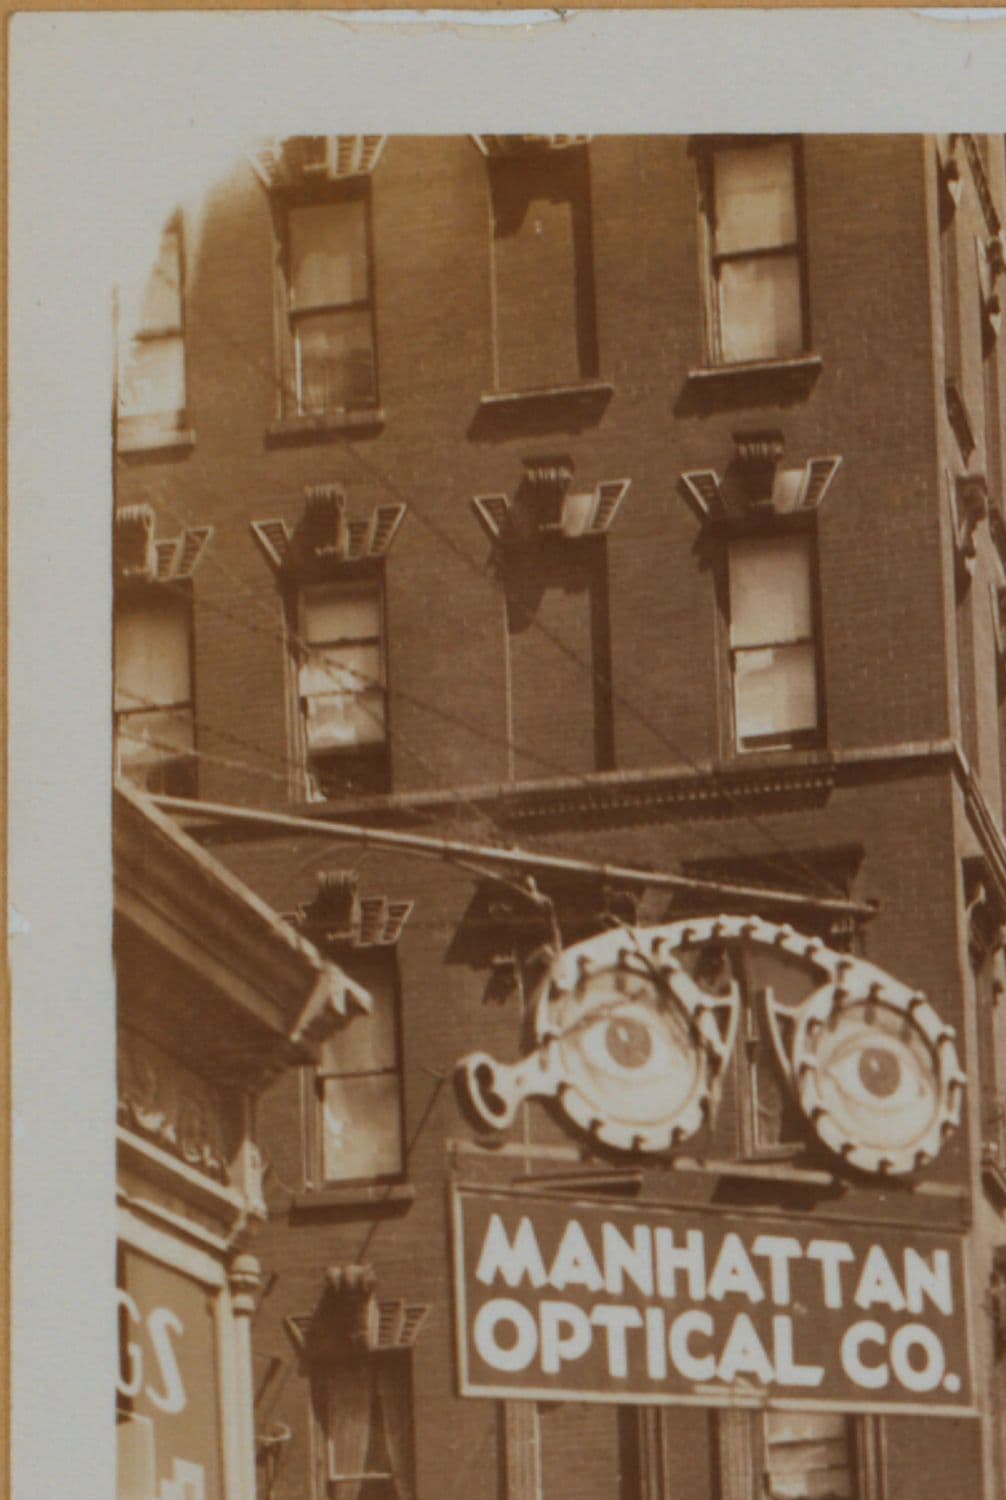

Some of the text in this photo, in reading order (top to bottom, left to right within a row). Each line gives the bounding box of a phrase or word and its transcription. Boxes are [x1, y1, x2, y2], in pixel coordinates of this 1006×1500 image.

[476, 1214, 954, 1316] MANHATTAN
[474, 1298, 961, 1393] OPTICAL CO.
